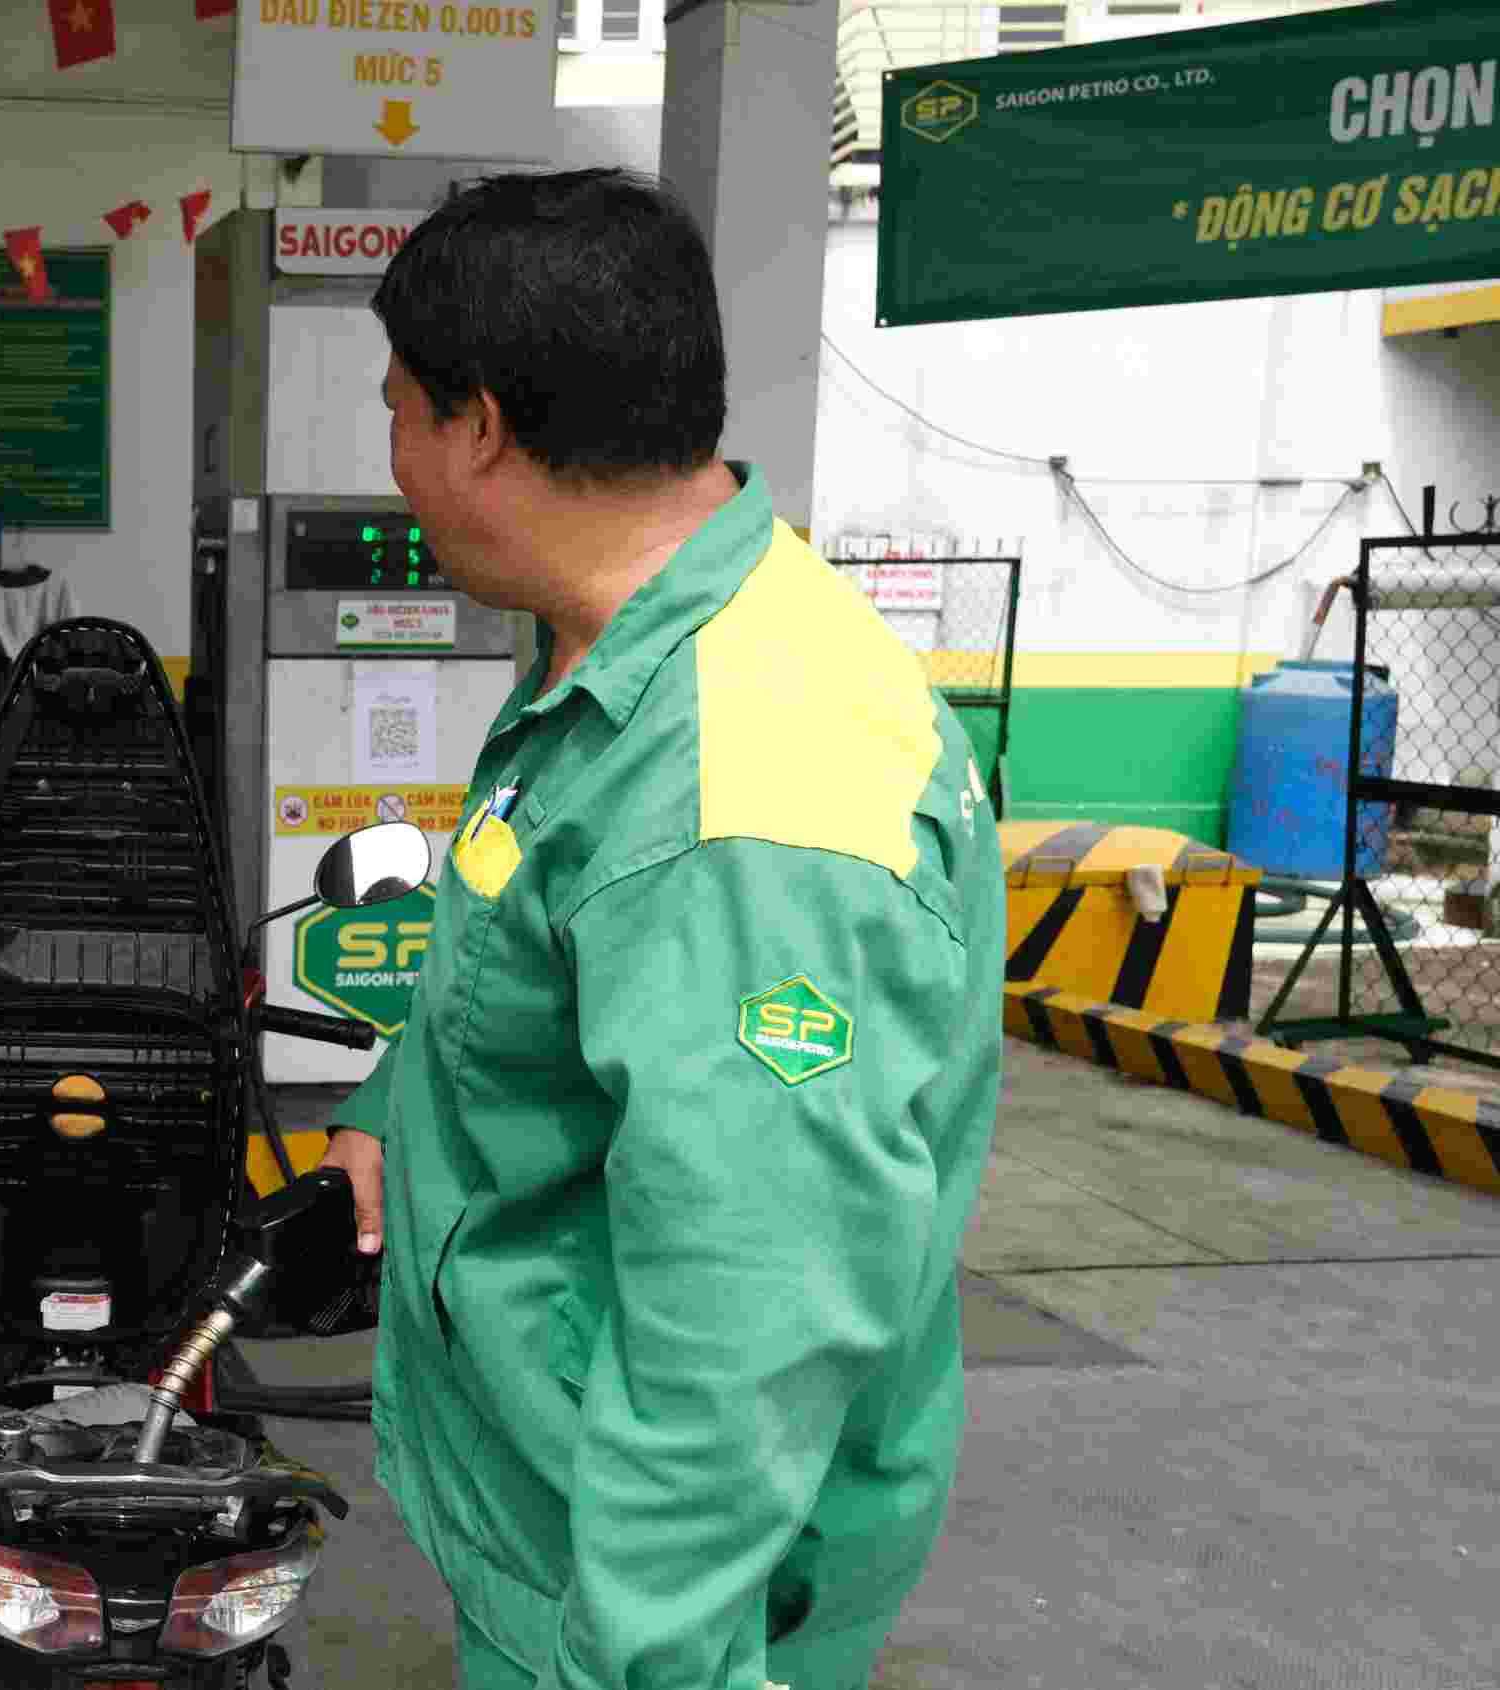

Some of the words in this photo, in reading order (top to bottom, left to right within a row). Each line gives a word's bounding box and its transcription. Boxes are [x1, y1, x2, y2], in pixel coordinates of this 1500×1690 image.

[425, 57, 444, 86] 5
[996, 86, 1064, 111] SAIGON
[1069, 77, 1129, 100] PETRO
[1175, 67, 1213, 88] LTD.
[1329, 59, 1497, 149] CHỌN
[1195, 182, 1316, 255] ĐỘNG
[1321, 172, 1389, 232] CƠ
[336, 971, 394, 988] SAIGON
[757, 1003, 835, 1041] SP
